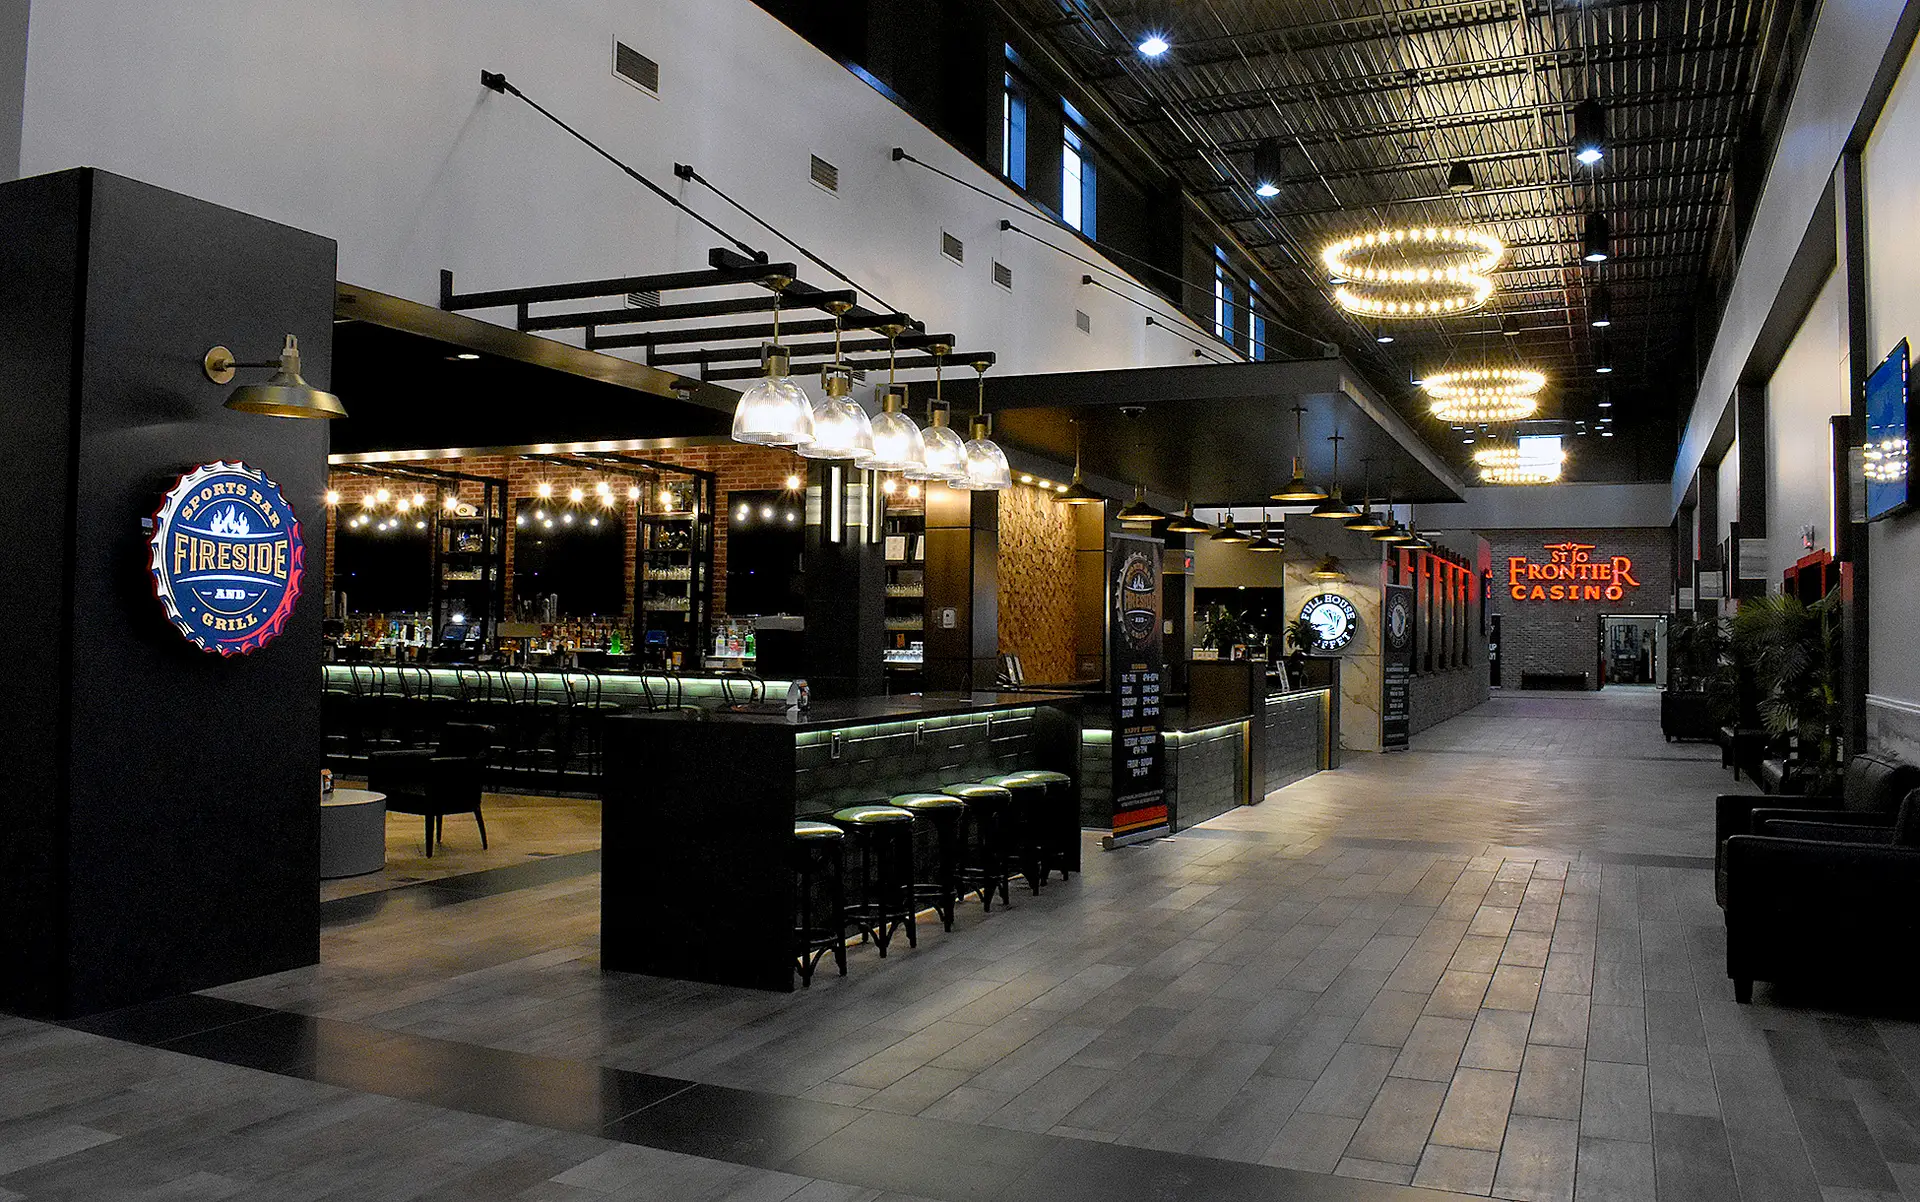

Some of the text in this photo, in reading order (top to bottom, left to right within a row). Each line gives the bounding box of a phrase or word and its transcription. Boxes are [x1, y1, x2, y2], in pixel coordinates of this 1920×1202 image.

[181, 482, 281, 528] SPORTS BAR
[174, 531, 288, 580] FIRESIDE
[1551, 550, 1589, 566] ST JO
[1507, 556, 1641, 586] FRONTIER
[215, 588, 246, 601] AND
[1511, 585, 1624, 601] CASINO
[1300, 596, 1323, 621] FULL
[1324, 594, 1357, 620] HOUSE
[202, 611, 258, 631] GRILL
[1311, 631, 1352, 650] FFET
